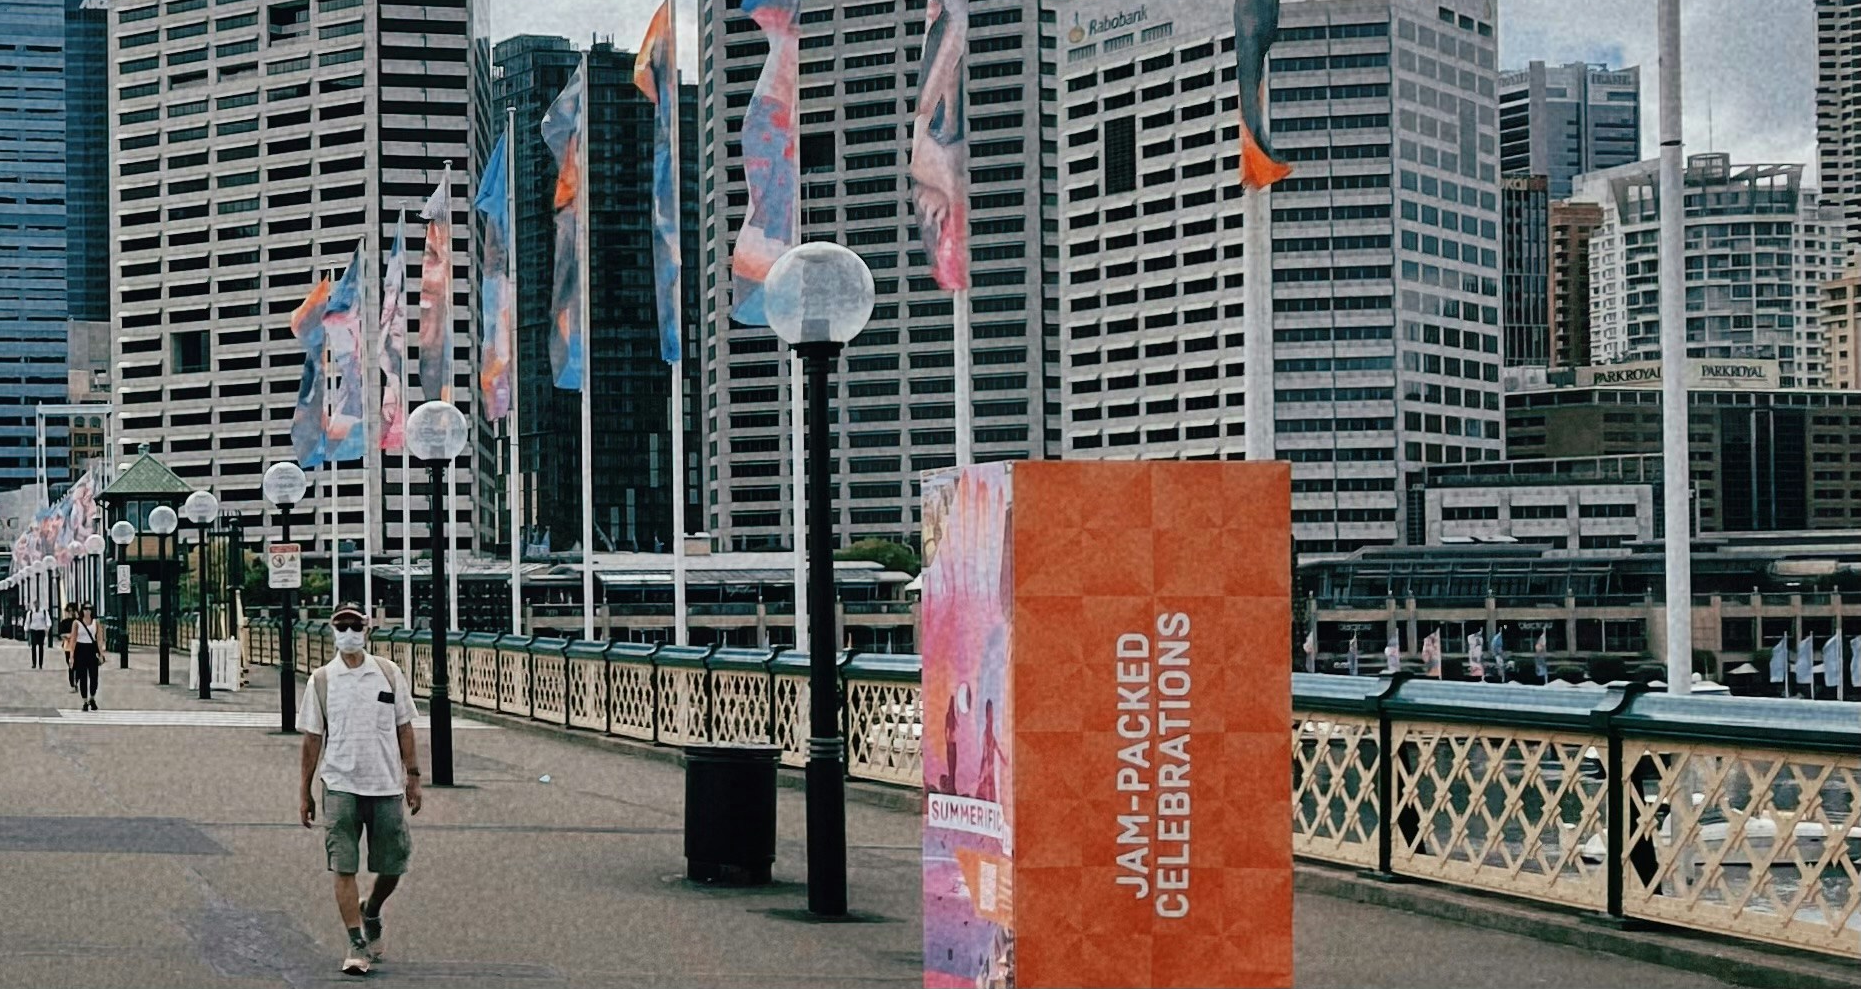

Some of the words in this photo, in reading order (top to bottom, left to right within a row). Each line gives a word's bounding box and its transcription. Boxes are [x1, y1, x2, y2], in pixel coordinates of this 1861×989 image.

[1089, 4, 1147, 36] Rabobank
[1701, 365, 1766, 378] PARKROYAL
[1116, 633, 1149, 899] JAM-PACKED
[1155, 612, 1190, 918] CELEBRATIONS
[931, 800, 1002, 832] SUMMERIFIC
